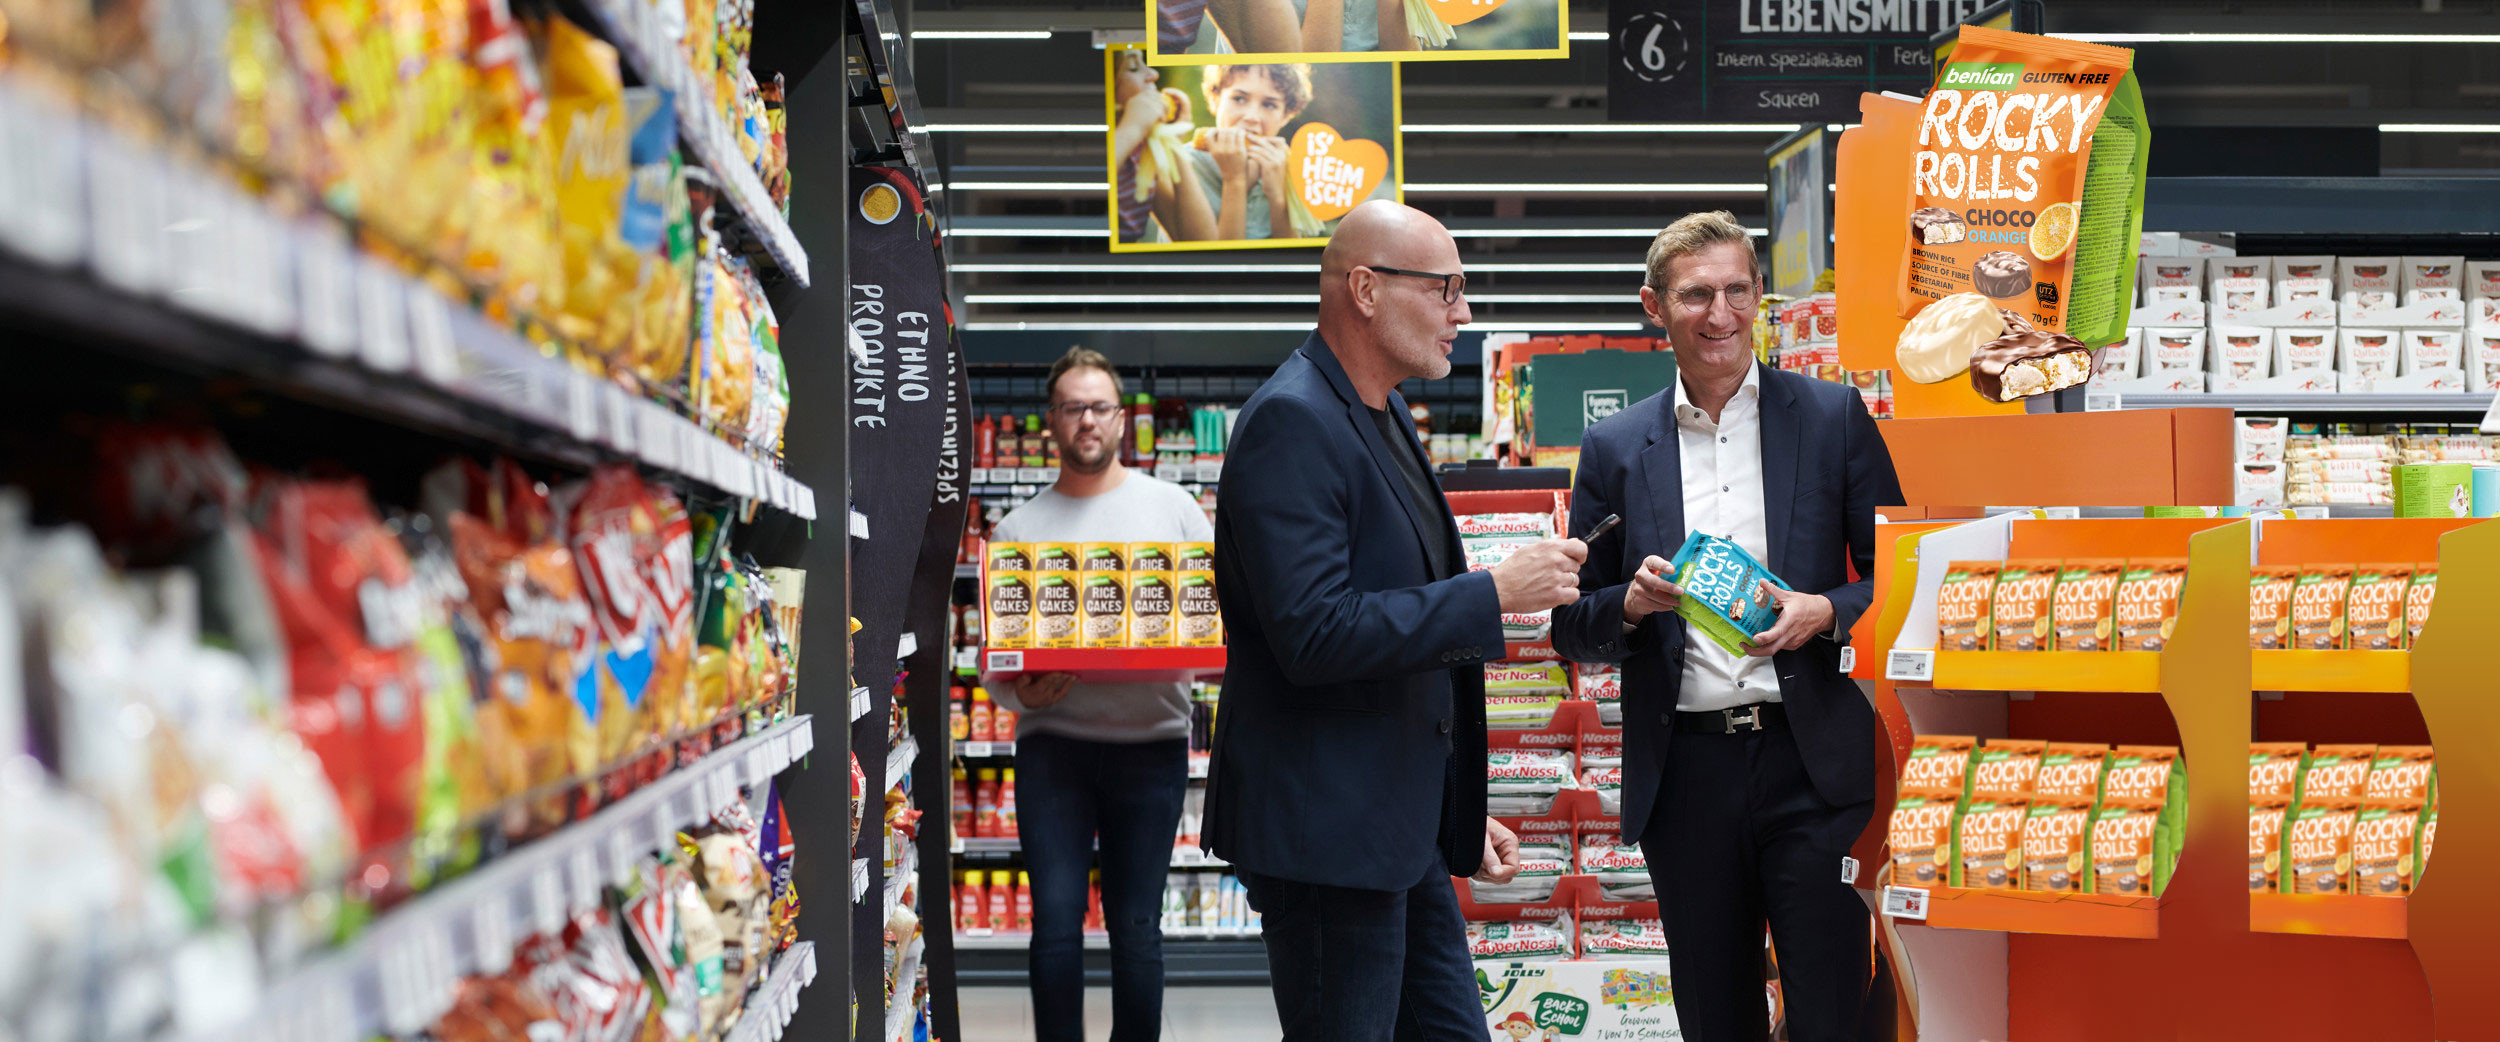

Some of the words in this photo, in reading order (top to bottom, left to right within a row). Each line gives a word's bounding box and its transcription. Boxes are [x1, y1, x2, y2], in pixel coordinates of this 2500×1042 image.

[1641, 23, 1666, 71] 6
[1716, 52, 1763, 67] Intern
[1770, 51, 1863, 72] Spezialitäten
[2023, 72, 2074, 84] GLUTEN
[2078, 73, 2110, 84] FREE
[1758, 90, 1820, 108] Saucen
[1919, 89, 2103, 153] ROCKY
[1916, 151, 2040, 202] ROLLS
[1966, 209, 2036, 227] CHOCO
[1968, 229, 2027, 244] ORANGE
[1912, 248, 1939, 261] BROWN
[1940, 253, 1956, 264] RICE
[1911, 261, 1938, 274] SOURCE
[1940, 267, 1950, 276] OF
[1951, 270, 1970, 281] FIBRE
[1911, 274, 1954, 290] VEGETARIAN
[1910, 286, 1929, 298] PALM
[852, 284, 887, 430] PRODUKTE
[897, 311, 930, 402] ETHNO
[1000, 559, 1024, 571] RICE
[1045, 559, 1069, 571] RICE
[1092, 559, 1116, 571] RICE
[1140, 559, 1165, 571] RICE
[1187, 559, 1211, 571] RICE
[1685, 537, 1732, 600] ROCKY
[1709, 560, 1743, 610] ROLLS
[1739, 565, 1753, 592] CHOCO
[1000, 587, 1024, 599] RICE
[1045, 587, 1069, 599] RICE
[1092, 587, 1116, 599] RICE
[1140, 587, 1165, 599] RICE
[1187, 587, 1211, 599] RICE
[1940, 577, 1994, 603] ROCKY
[1995, 576, 2054, 603] ROCKY
[2055, 576, 2117, 603] ROCKY
[2118, 576, 2182, 603] ROCKY
[2250, 581, 2292, 604] OCKY
[2294, 580, 2348, 604] ROCKY
[2350, 580, 2406, 604] ROCKY
[994, 600, 1029, 612] CAKES
[1040, 600, 1075, 612] CAKES
[1086, 600, 1122, 612] CAKES
[1135, 600, 1170, 612] CAKES
[1181, 600, 1217, 612] CAKES
[1940, 602, 1977, 620] ROLLS
[1995, 602, 2035, 620] ROLLS
[2055, 602, 2097, 621] ROLLS
[2118, 602, 2162, 621] ROLLS
[2294, 604, 2331, 620] ROLLS
[2350, 604, 2389, 621] ROLLS
[1905, 753, 1968, 780] ROCKY
[1976, 758, 2039, 784] ROCKY
[2038, 761, 2101, 787] ROCKY
[2107, 763, 2170, 789] ROCKY
[2250, 760, 2298, 786] OCKY
[2306, 762, 2368, 789] ROCKY
[2368, 763, 2430, 791] ROCKY
[1891, 805, 1954, 830] ROCKY
[1962, 809, 2025, 835] ROCKY
[2024, 812, 2087, 838] ROCKY
[2292, 813, 2354, 841] ROCKY
[2093, 814, 2157, 841] ROCKY
[2355, 815, 2417, 842] ROCKY
[1891, 829, 1935, 848] ROLLS
[1961, 834, 2006, 853] ROLLS
[2024, 837, 2068, 856] ROLLS
[2093, 840, 2137, 859] ROLLS
[2292, 839, 2336, 859] ROLLS
[2354, 841, 2398, 860] ROLLS
[1502, 969, 1545, 977] JOLLY
[1543, 998, 1576, 1013] BACK
